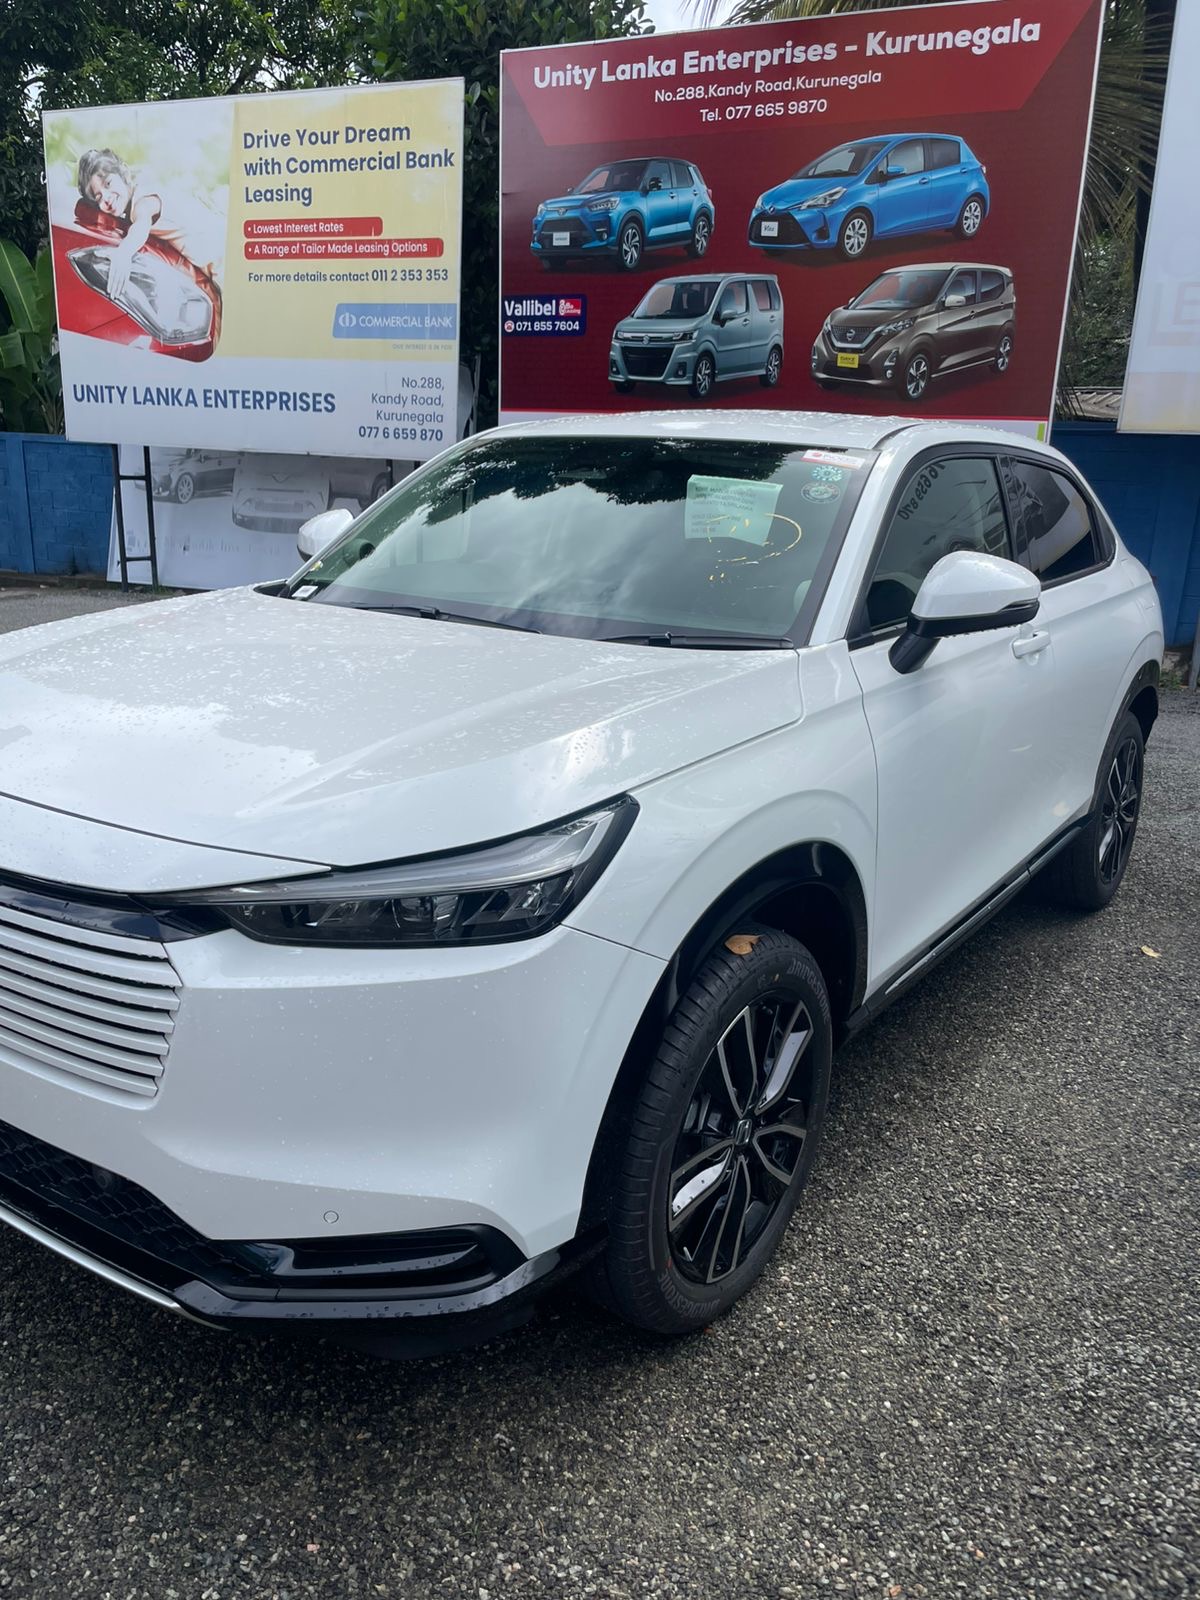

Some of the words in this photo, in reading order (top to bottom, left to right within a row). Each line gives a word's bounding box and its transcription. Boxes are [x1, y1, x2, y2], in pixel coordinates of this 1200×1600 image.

[534, 63, 597, 90] Unity
[601, 55, 676, 82] Lanka
[683, 40, 838, 74] Enterprises
[865, 18, 1041, 56] Kurunegala
[700, 108, 722, 122] Tel.
[726, 105, 751, 120] 077
[754, 102, 784, 118] 665
[788, 99, 828, 115] 9870
[243, 129, 291, 149] Drive
[296, 127, 340, 146] Your
[344, 125, 411, 144] Dream
[244, 157, 282, 176] with
[286, 151, 401, 174] Commercial
[405, 148, 455, 170] Bank
[244, 182, 313, 207] Leasing
[253, 222, 283, 234] Lowest
[284, 221, 317, 234] Interest
[318, 221, 344, 233] Rates
[253, 244, 260, 255] A
[261, 244, 290, 257] Range
[291, 243, 300, 254] of
[301, 242, 326, 255] Tailor
[328, 242, 353, 254] Made
[354, 241, 389, 256] Leasing
[391, 241, 428, 255] Options
[248, 271, 264, 282] For
[265, 273, 292, 282] more
[293, 270, 327, 282] details
[329, 270, 369, 282] contact
[371, 269, 388, 281] 011
[390, 269, 398, 281] 2
[400, 269, 423, 281] 353
[425, 268, 448, 281] 353
[504, 299, 556, 316] Vallibel
[359, 315, 422, 328] COMMERCIAL
[424, 315, 453, 328] BANK
[516, 321, 532, 331] 071
[533, 321, 553, 331] 855
[554, 320, 580, 331] 7604
[401, 377, 445, 390] No.288,
[72, 383, 128, 406] UNITY
[132, 386, 198, 409] LANKA
[203, 389, 336, 413] ENTERPRISES
[371, 392, 408, 408] Kandy
[411, 394, 444, 408] Road,
[376, 410, 444, 426] Kurunegala
[358, 425, 380, 438] 077
[382, 427, 390, 439] 6
[393, 427, 417, 440] 659
[420, 428, 443, 441] 870
